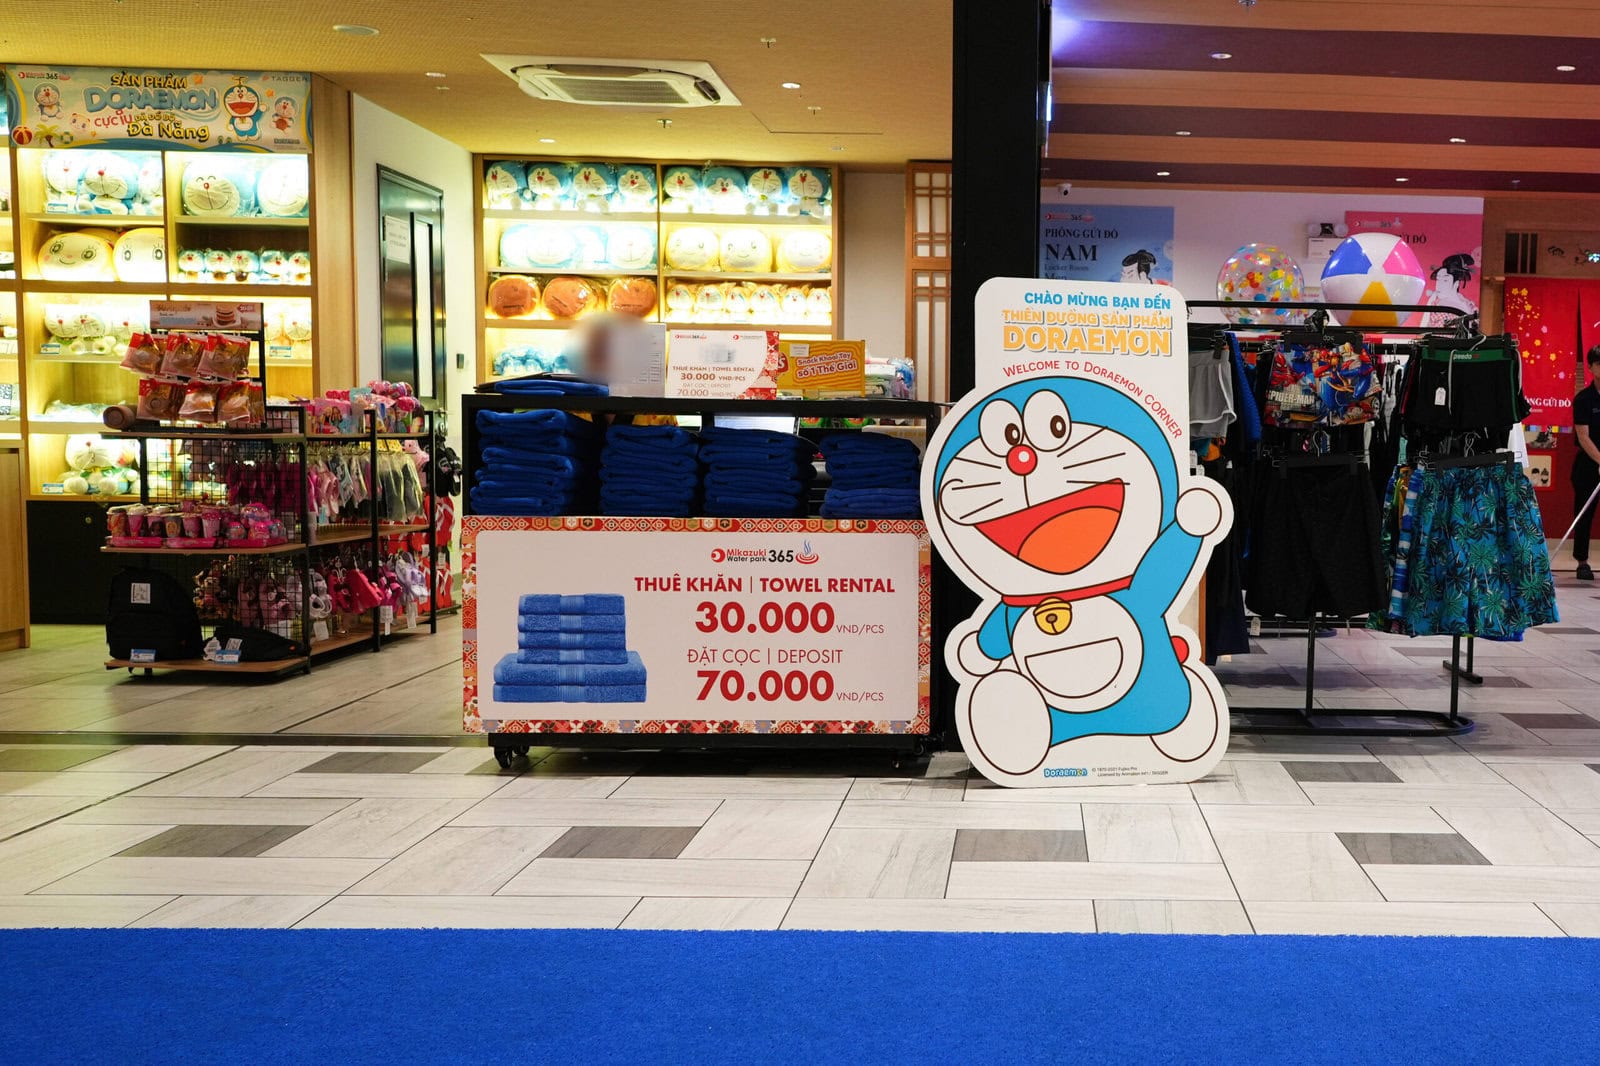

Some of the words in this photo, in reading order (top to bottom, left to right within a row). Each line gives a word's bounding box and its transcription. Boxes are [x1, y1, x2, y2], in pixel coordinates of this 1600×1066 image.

[111, 71, 141, 87] SẢN
[144, 73, 188, 89] PHẨM
[83, 87, 217, 112] DORAEMON
[127, 121, 153, 136] Đà
[158, 120, 210, 142] Nẵng
[1045, 244, 1097, 261] NAM
[1024, 290, 1063, 305] CHÀO
[1067, 292, 1108, 307] MỪNG
[1112, 296, 1140, 310] BẠN
[1144, 293, 1171, 309] ĐẾN
[1002, 308, 1043, 323] THIÊN
[1046, 309, 1098, 326] ĐƯỜNG
[1101, 310, 1131, 327] SẢN
[1133, 311, 1172, 329] PHẨM
[1003, 325, 1172, 356] DORAEMON
[677, 389, 709, 397] 70.000
[726, 548, 767, 557] Mikazuki
[768, 550, 794, 563] 365
[634, 573, 681, 592] THUÊ
[686, 574, 742, 592] KHĂN
[759, 577, 822, 592] TOWEL
[828, 578, 895, 592] RENTAL
[695, 602, 835, 633] 30.000
[836, 624, 884, 635] VND/PCS
[687, 646, 718, 666] ĐẶT
[722, 649, 761, 666] CỌC
[778, 649, 843, 663] DEPOSIT
[696, 670, 834, 701] 70.000
[836, 692, 884, 703] VND/PCS
[1043, 768, 1088, 777] Doraemon
